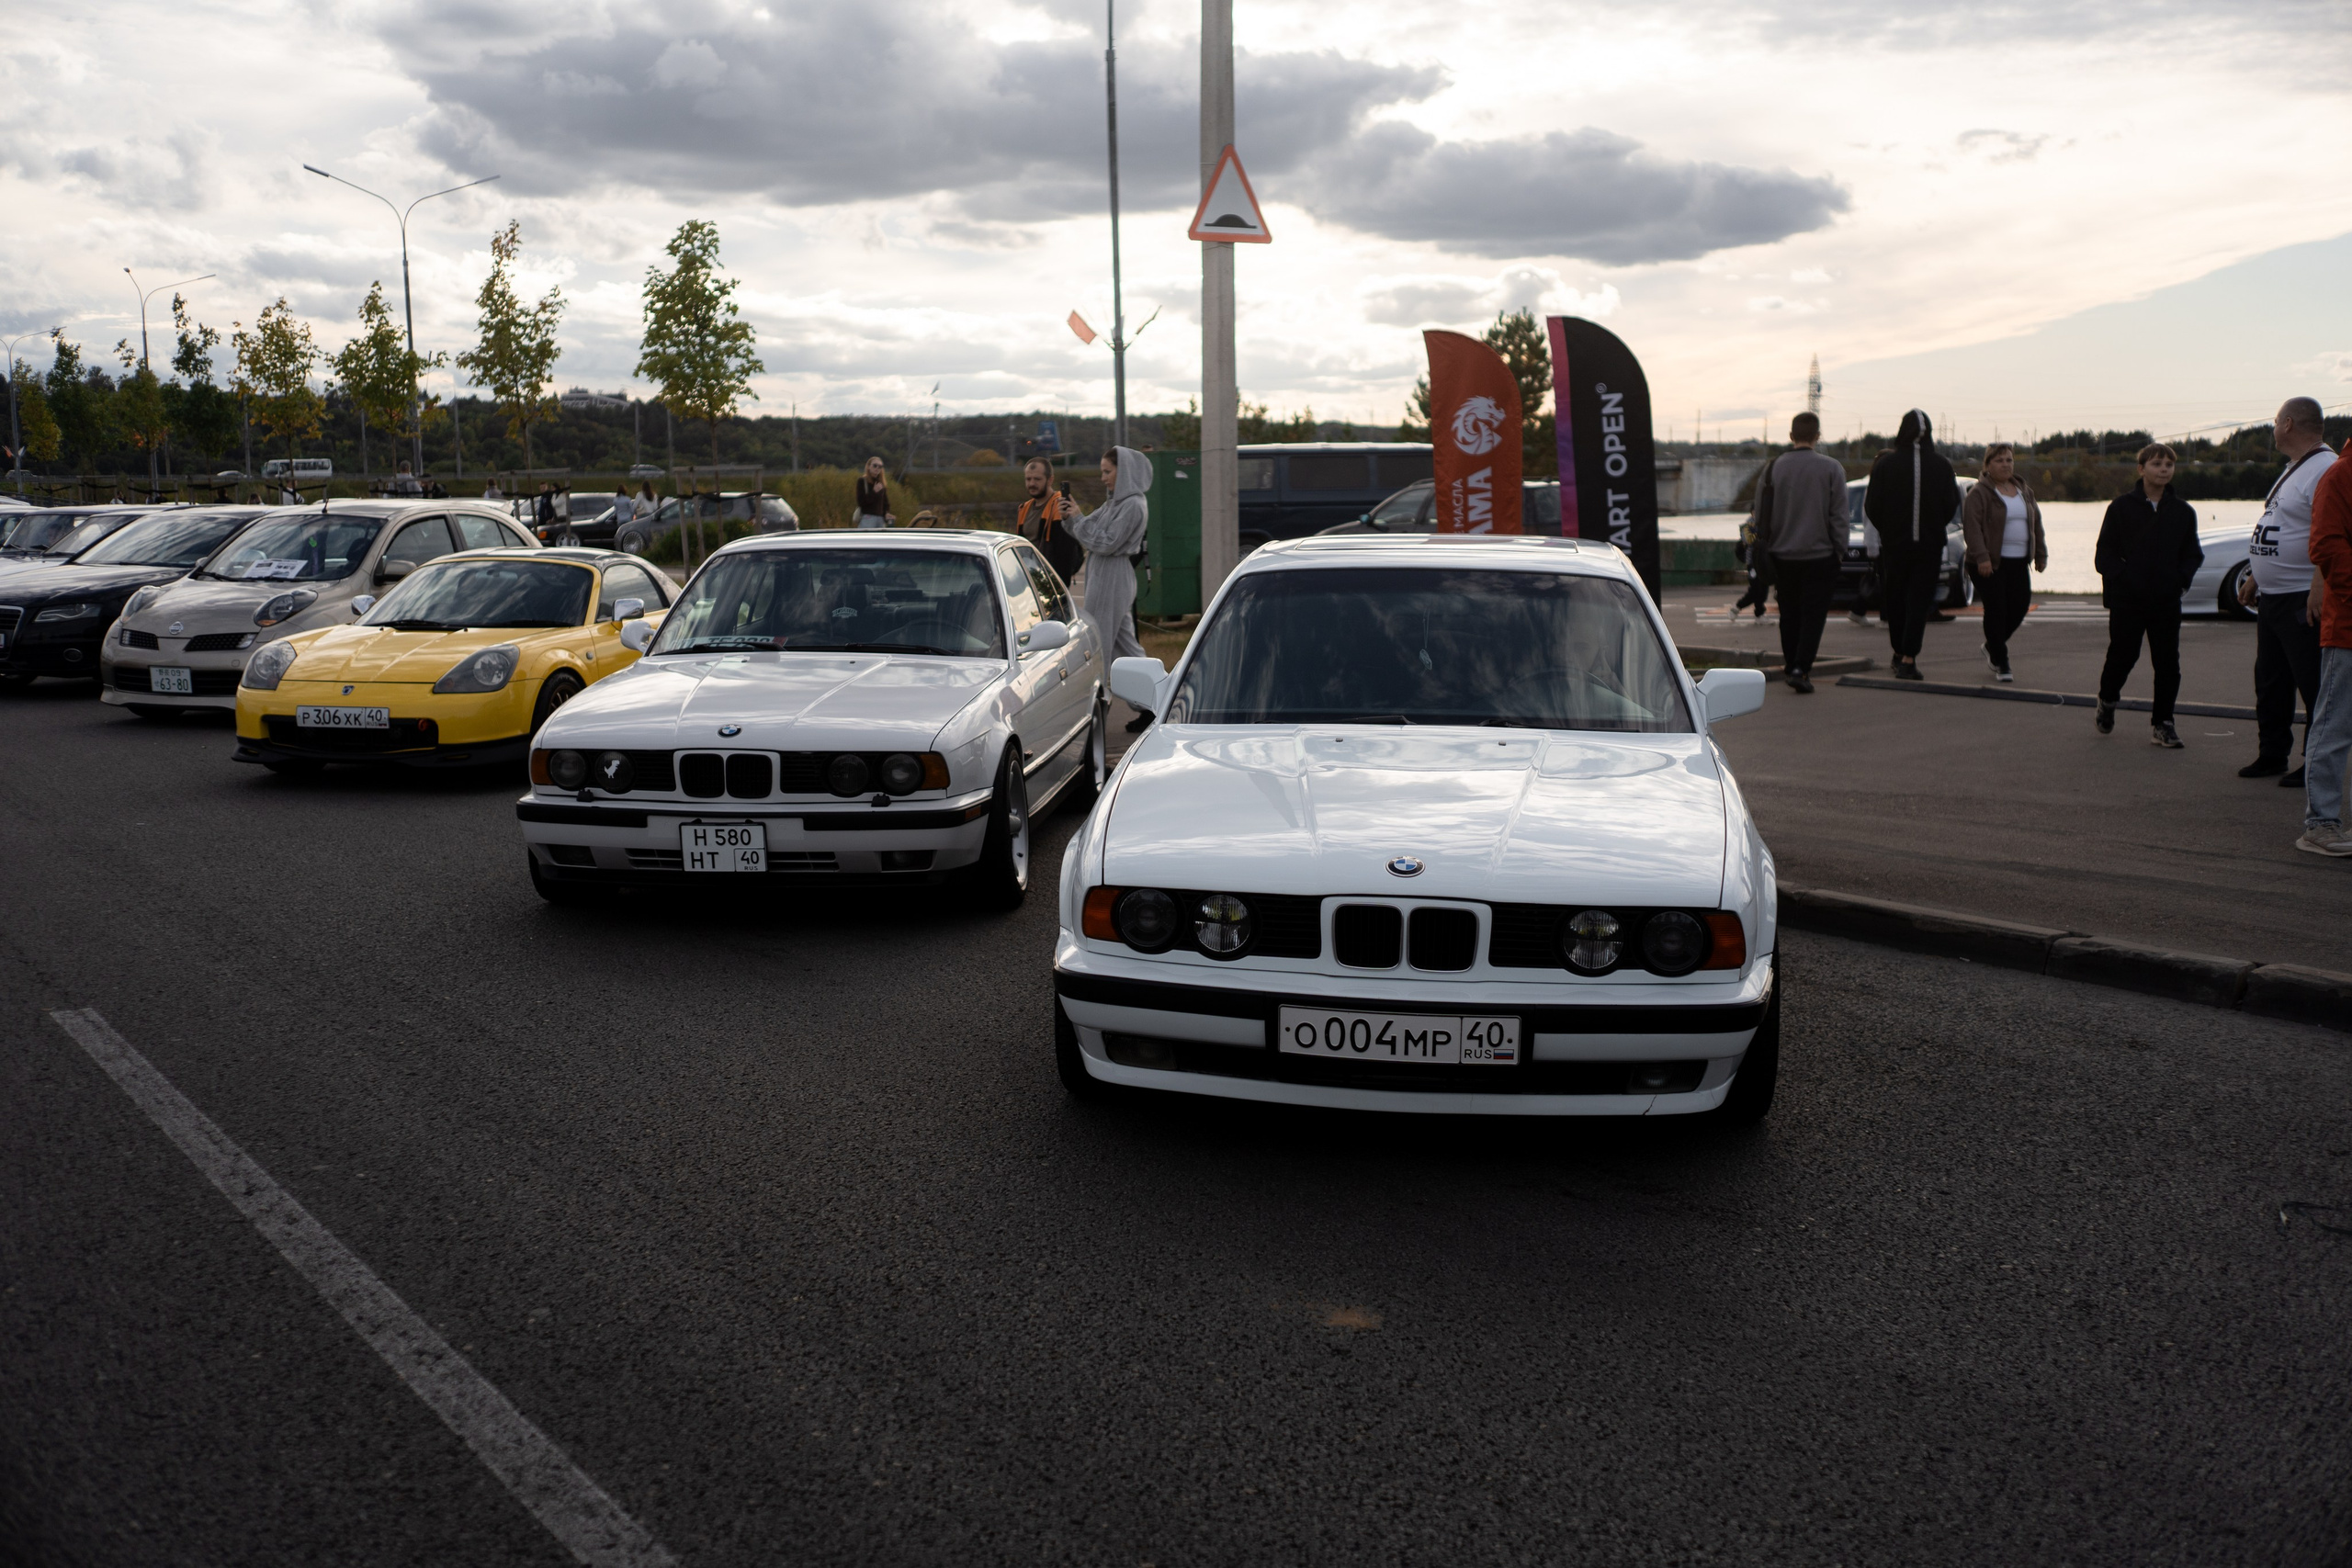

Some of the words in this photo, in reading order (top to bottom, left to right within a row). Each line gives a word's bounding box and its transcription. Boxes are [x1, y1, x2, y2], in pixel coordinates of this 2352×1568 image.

[1600, 392, 1629, 477] OPEN
[1607, 489, 1633, 554] ART
[160, 677, 189, 691] 63-80
[367, 708, 383, 722] 40
[741, 851, 760, 864] 40
[1466, 1021, 1505, 1048] 40
[1464, 1048, 1493, 1060] RUS
